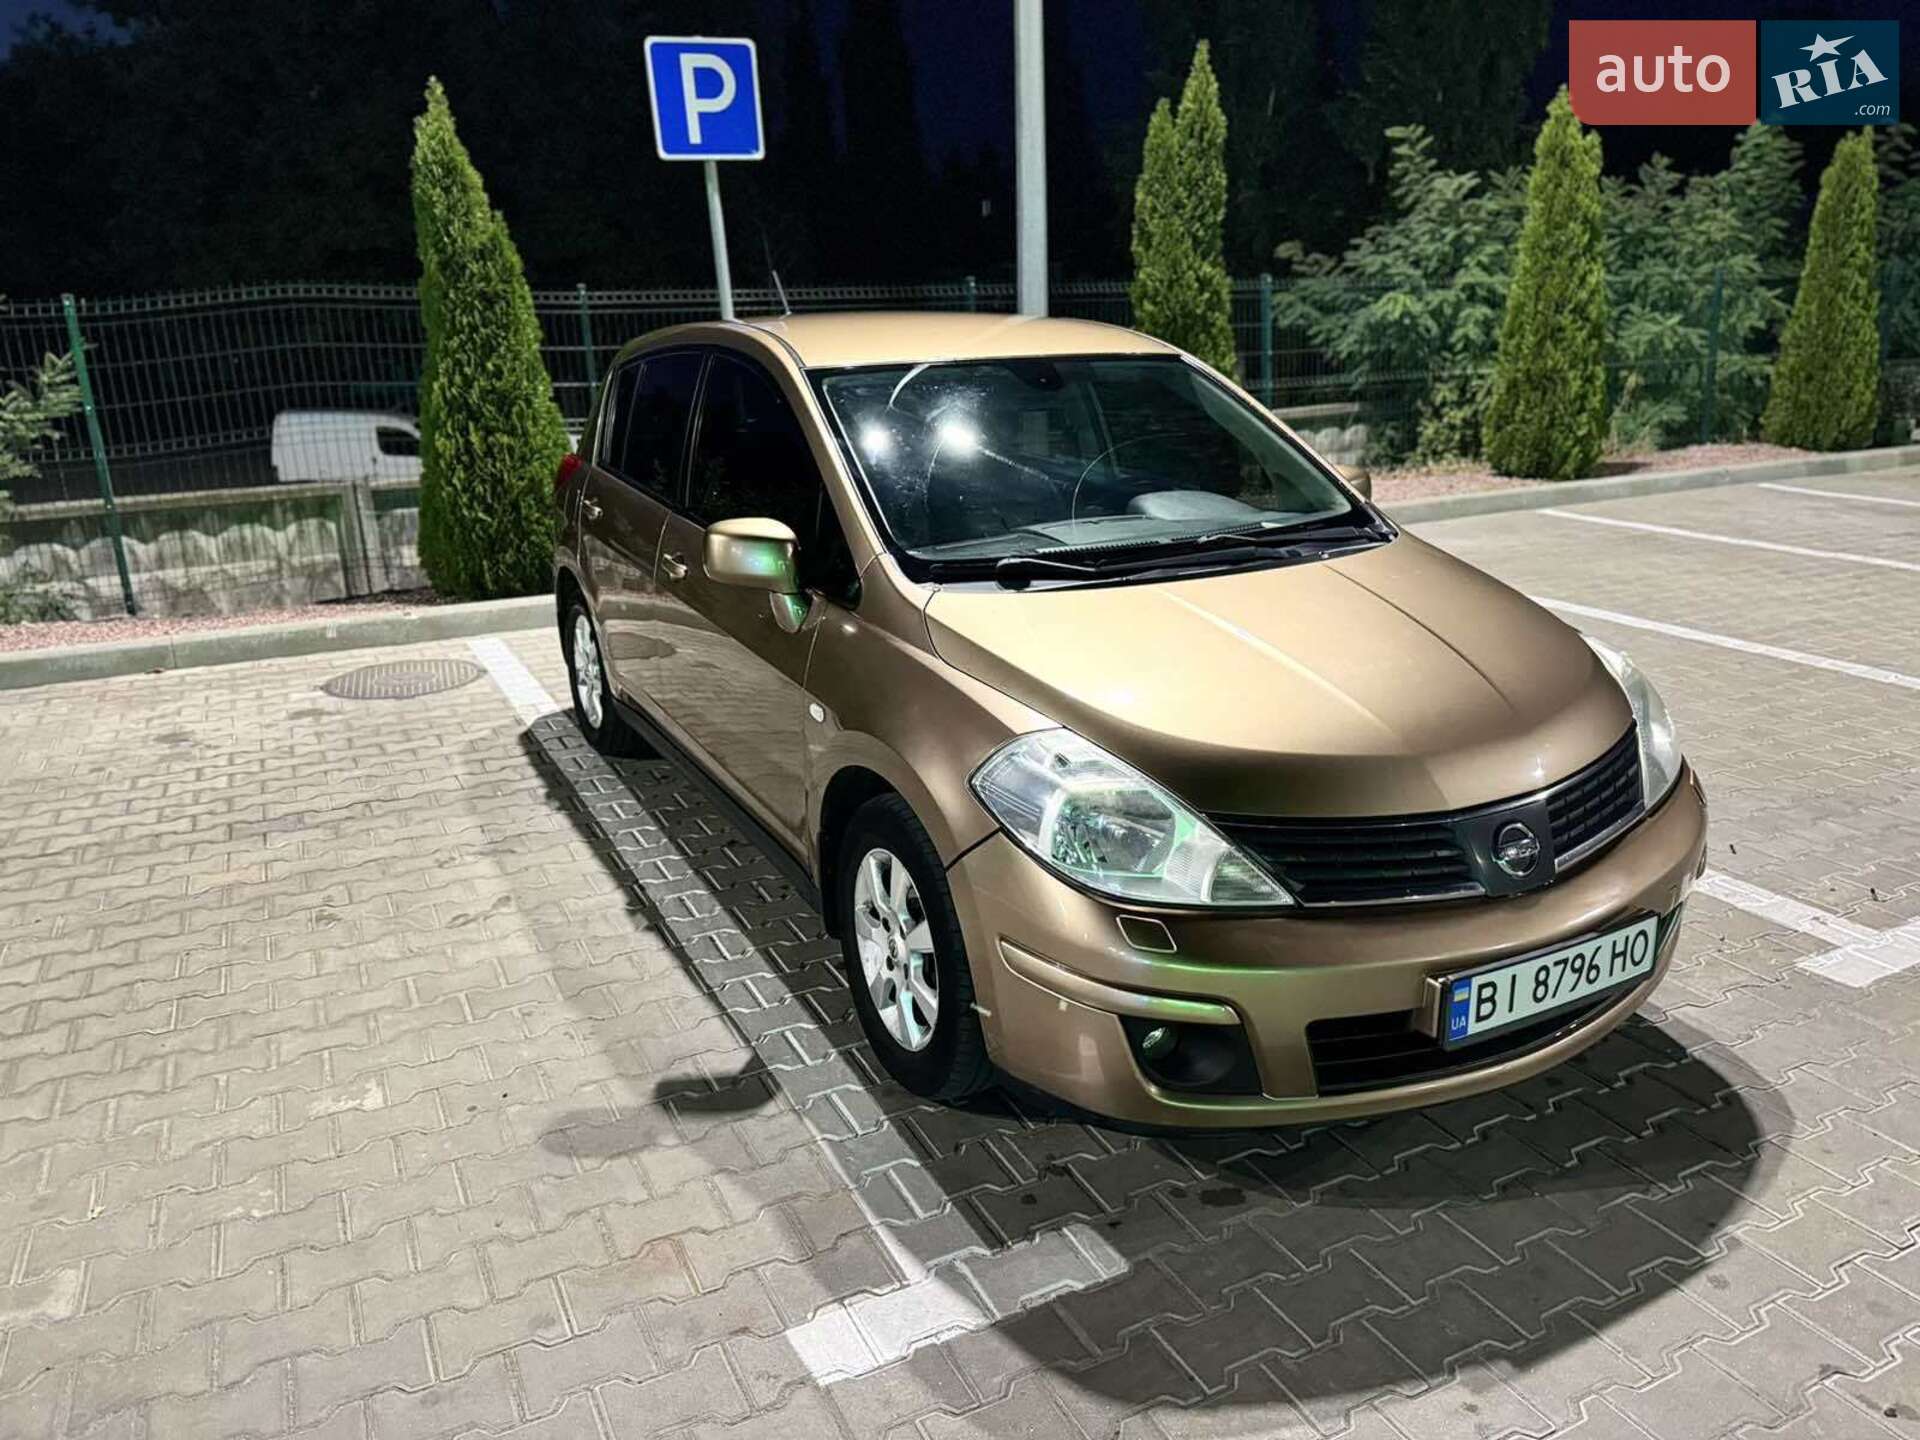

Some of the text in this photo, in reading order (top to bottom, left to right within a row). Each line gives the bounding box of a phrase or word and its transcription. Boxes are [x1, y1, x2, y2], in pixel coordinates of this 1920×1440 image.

[680, 53, 736, 144] P
[1475, 929, 1649, 1023] BI 8796 HO
[1451, 1017, 1466, 1031] UA
